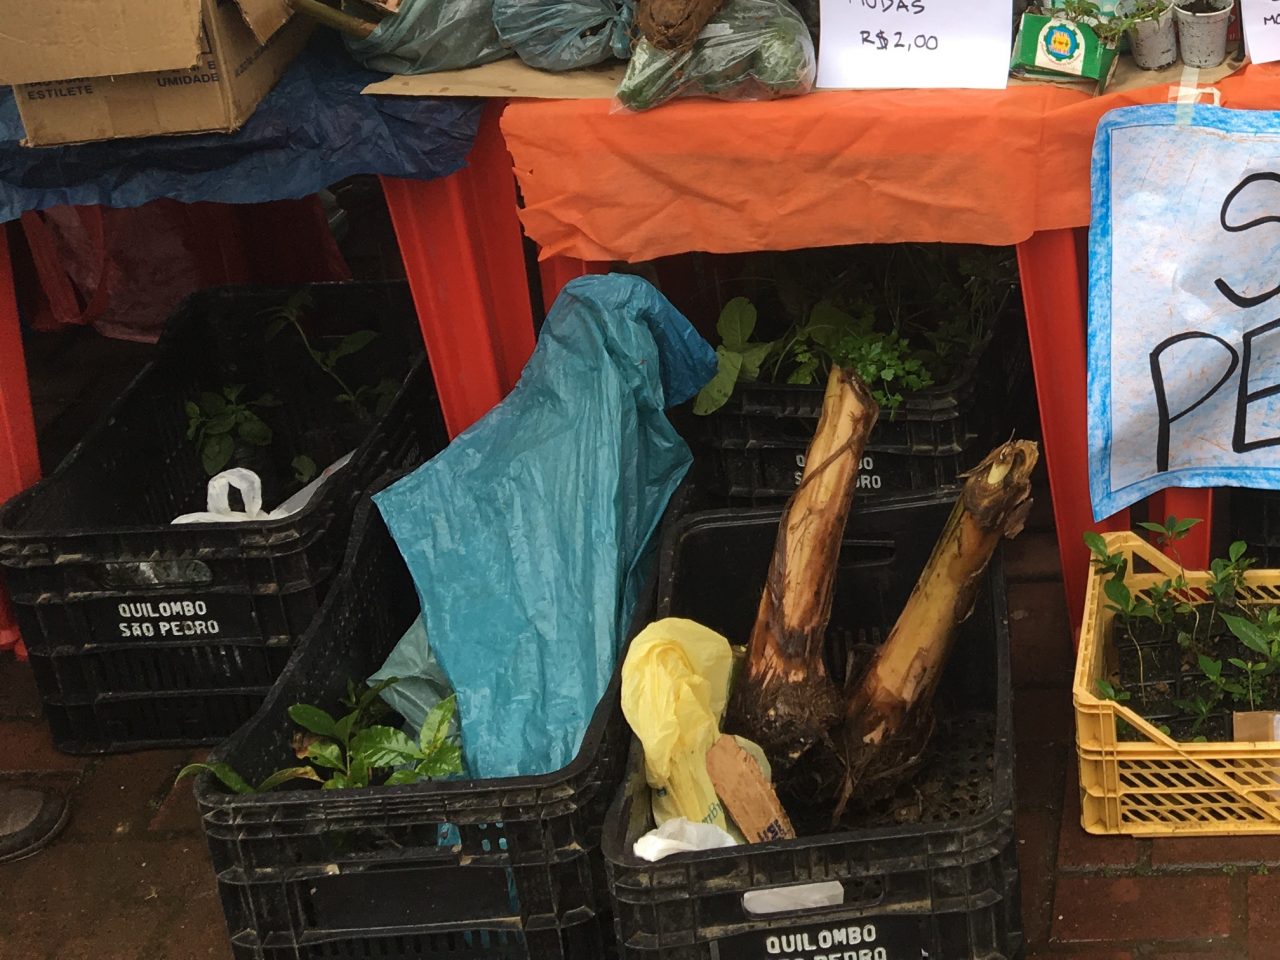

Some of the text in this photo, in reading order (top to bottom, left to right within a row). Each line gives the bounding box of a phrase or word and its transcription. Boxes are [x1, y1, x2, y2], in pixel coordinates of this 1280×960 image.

[157, 72, 219, 88] UMIDADE
[27, 85, 93, 101] ESTILETE
[118, 600, 207, 618] QUILOMBO
[119, 619, 220, 637] SÃO PEDRO
[765, 924, 877, 954] QUILOMBO
